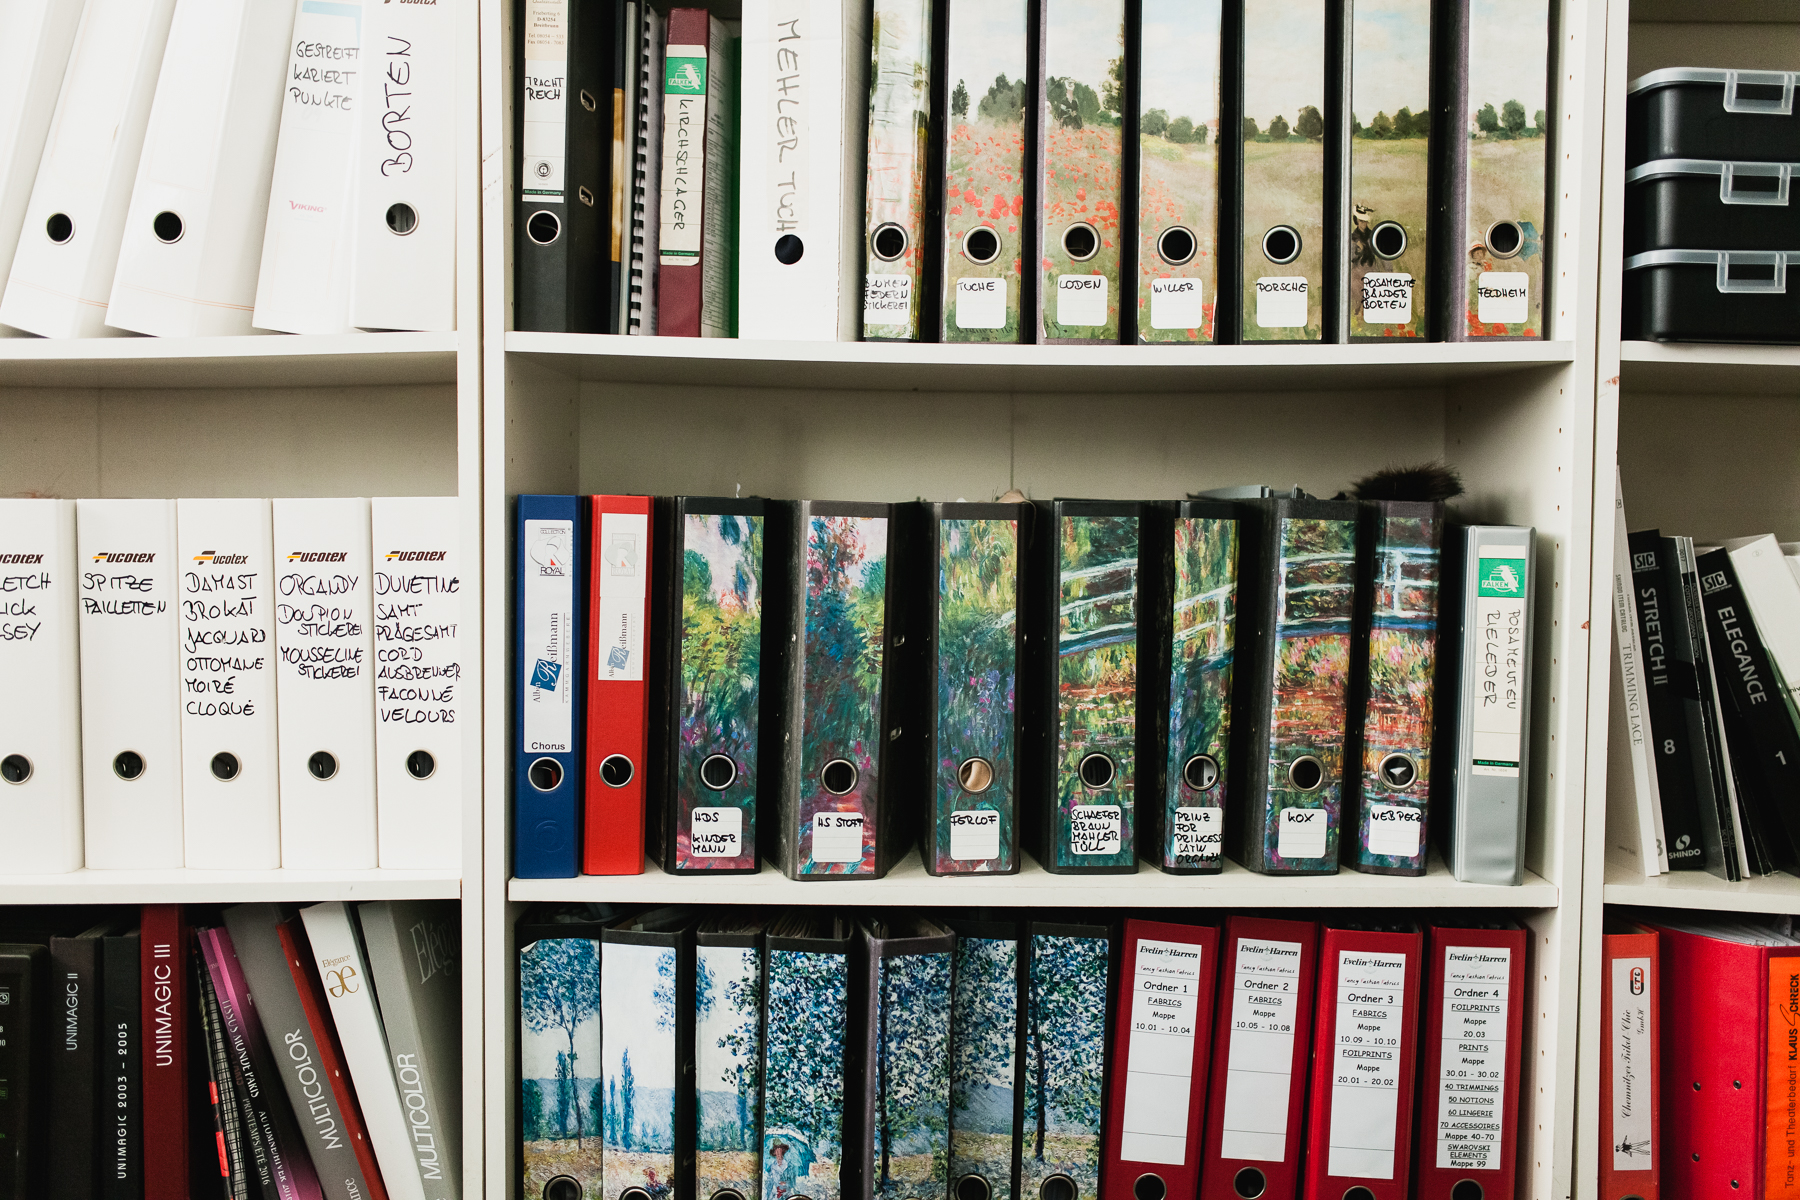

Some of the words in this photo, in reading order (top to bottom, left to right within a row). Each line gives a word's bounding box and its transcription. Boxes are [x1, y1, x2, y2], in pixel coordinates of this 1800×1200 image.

[296, 41, 360, 60] GESTREIFT
[293, 64, 357, 85] KARIERT
[525, 76, 564, 88] TRACHT
[526, 87, 561, 101] REICH
[776, 18, 801, 163] MEHLER
[289, 87, 353, 111] PUNKTE
[381, 36, 413, 178] BORTEN
[673, 99, 694, 231] KIRCHSCHLAGER
[289, 200, 326, 214] VIKING
[776, 171, 799, 232] TUCH
[957, 281, 996, 292] TUCHE
[1059, 278, 1102, 290] LODEN
[1153, 282, 1195, 294] WILLER
[1477, 287, 1527, 298] FELDHEIM
[863, 299, 908, 310] STICKEREI
[1361, 299, 1407, 310] BORTEN
[1636, 553, 1655, 568] SIC
[540, 566, 565, 575] ROYAL
[0, 572, 51, 592] ETCH
[82, 573, 154, 592] SPITZE
[185, 572, 258, 593] DAMAST
[279, 573, 359, 596] ORGANDY
[374, 571, 460, 596] DUVETINE
[1482, 580, 1510, 588] FALKEN
[1703, 572, 1727, 590] SIC
[82, 597, 166, 616] PAILLETTEN
[183, 596, 257, 622] BROKAT
[376, 603, 423, 621] SAMT
[277, 603, 353, 625] DOUPION
[297, 620, 363, 638] STICKEREI
[375, 622, 458, 643] PRÄGESAMT
[1641, 587, 1667, 671] STRETCH
[185, 627, 266, 654] JACQUARD
[280, 645, 364, 664] MOUSSELINE
[377, 646, 423, 663] CORD
[1506, 608, 1521, 710] POSAMENTEN
[1717, 606, 1768, 705] ELEGANCE
[186, 657, 265, 673] OTTOMANE
[298, 663, 360, 680] STICKEREI
[377, 662, 461, 682] AUSBRENNER
[185, 675, 236, 694] MOIRÉ
[1622, 643, 1639, 712] TRIMMING
[186, 699, 255, 717] CLOQUÉ
[381, 707, 456, 724] VELOURS
[1629, 714, 1643, 746] LACE
[531, 741, 566, 751] Chorus
[1663, 739, 1676, 755] 8
[1775, 750, 1787, 766] 1
[695, 811, 720, 823] HDS
[818, 817, 831, 828] HS
[835, 817, 864, 828] STOFF
[1174, 811, 1211, 822] PRINZ
[1288, 812, 1315, 823] KOX
[1071, 820, 1111, 832] BRAUN
[1175, 823, 1198, 833] FOR
[692, 833, 737, 844] KINDER
[1072, 831, 1119, 842] MAHLER
[1174, 833, 1223, 844] PRINCESS
[691, 843, 726, 854] MANN
[1178, 843, 1207, 854] SATIN
[1668, 848, 1701, 860] SHINDO
[153, 943, 171, 959] III
[1139, 945, 1164, 956] Evelin
[1168, 949, 1198, 959] Harren
[1240, 944, 1264, 954] Evelin
[1269, 947, 1298, 957] Harren
[1343, 957, 1368, 966] Evelin
[1372, 960, 1402, 969] Harren
[1449, 953, 1473, 962] Evelin
[1478, 955, 1507, 963] Harren
[1143, 980, 1179, 993] Ordner
[1182, 984, 1188, 993] 1
[1243, 979, 1279, 991] Ordner
[1282, 982, 1289, 991] 2
[1248, 995, 1283, 1005] FABRICS
[1347, 993, 1383, 1004] Ordner
[1387, 995, 1394, 1004] 3
[1454, 988, 1489, 998] Ordner
[1492, 989, 1499, 998] 4
[1147, 997, 1182, 1008] FABRICS
[1451, 1003, 1500, 1012] FOILPRINTS
[66, 982, 79, 1051] UNIMAGIC
[154, 964, 174, 1068] UNIMAGIC
[1152, 1010, 1176, 1020] Mappe
[1252, 1009, 1276, 1019] Mappe
[1352, 1009, 1388, 1018] FABRICS
[1136, 1022, 1157, 1032] 10.01
[1168, 1026, 1191, 1034] 10.04
[1236, 1021, 1258, 1030] 10.05
[1268, 1023, 1291, 1032] 10.08
[1357, 1023, 1381, 1033] Mappe
[1463, 1017, 1487, 1026] Mappe
[117, 1022, 128, 1056] 2005
[1340, 1035, 1363, 1044] 10.09
[1374, 1037, 1397, 1046] 10.10
[1788, 1028, 1798, 1061] KLAUS
[1342, 1049, 1393, 1059] FOILPRINTS
[1459, 1043, 1489, 1052] PRINTS
[1356, 1063, 1380, 1073] Mappe
[1461, 1057, 1485, 1066] Mappe
[1446, 1069, 1467, 1077] 30.01
[1338, 1076, 1360, 1084] 20.01
[1371, 1078, 1394, 1086] 20.02
[1456, 1084, 1499, 1092] TRIMMINGS
[117, 1076, 128, 1109] 2003
[284, 1028, 343, 1150] MULTICOLOR
[1621, 1063, 1636, 1119] Chemnitzer
[1785, 1065, 1797, 1137] Theaterbedarf
[396, 1052, 443, 1180] MULTICOLOR
[1451, 1122, 1500, 1130] ACCESSOIRES
[1444, 1132, 1468, 1140] Mappe
[117, 1114, 128, 1180] UNIMAGIC
[1786, 1139, 1795, 1161] und
[1450, 1160, 1474, 1168] Mappe
[259, 1165, 271, 1187] 2016
[1784, 1161, 1795, 1190] Tanz-
